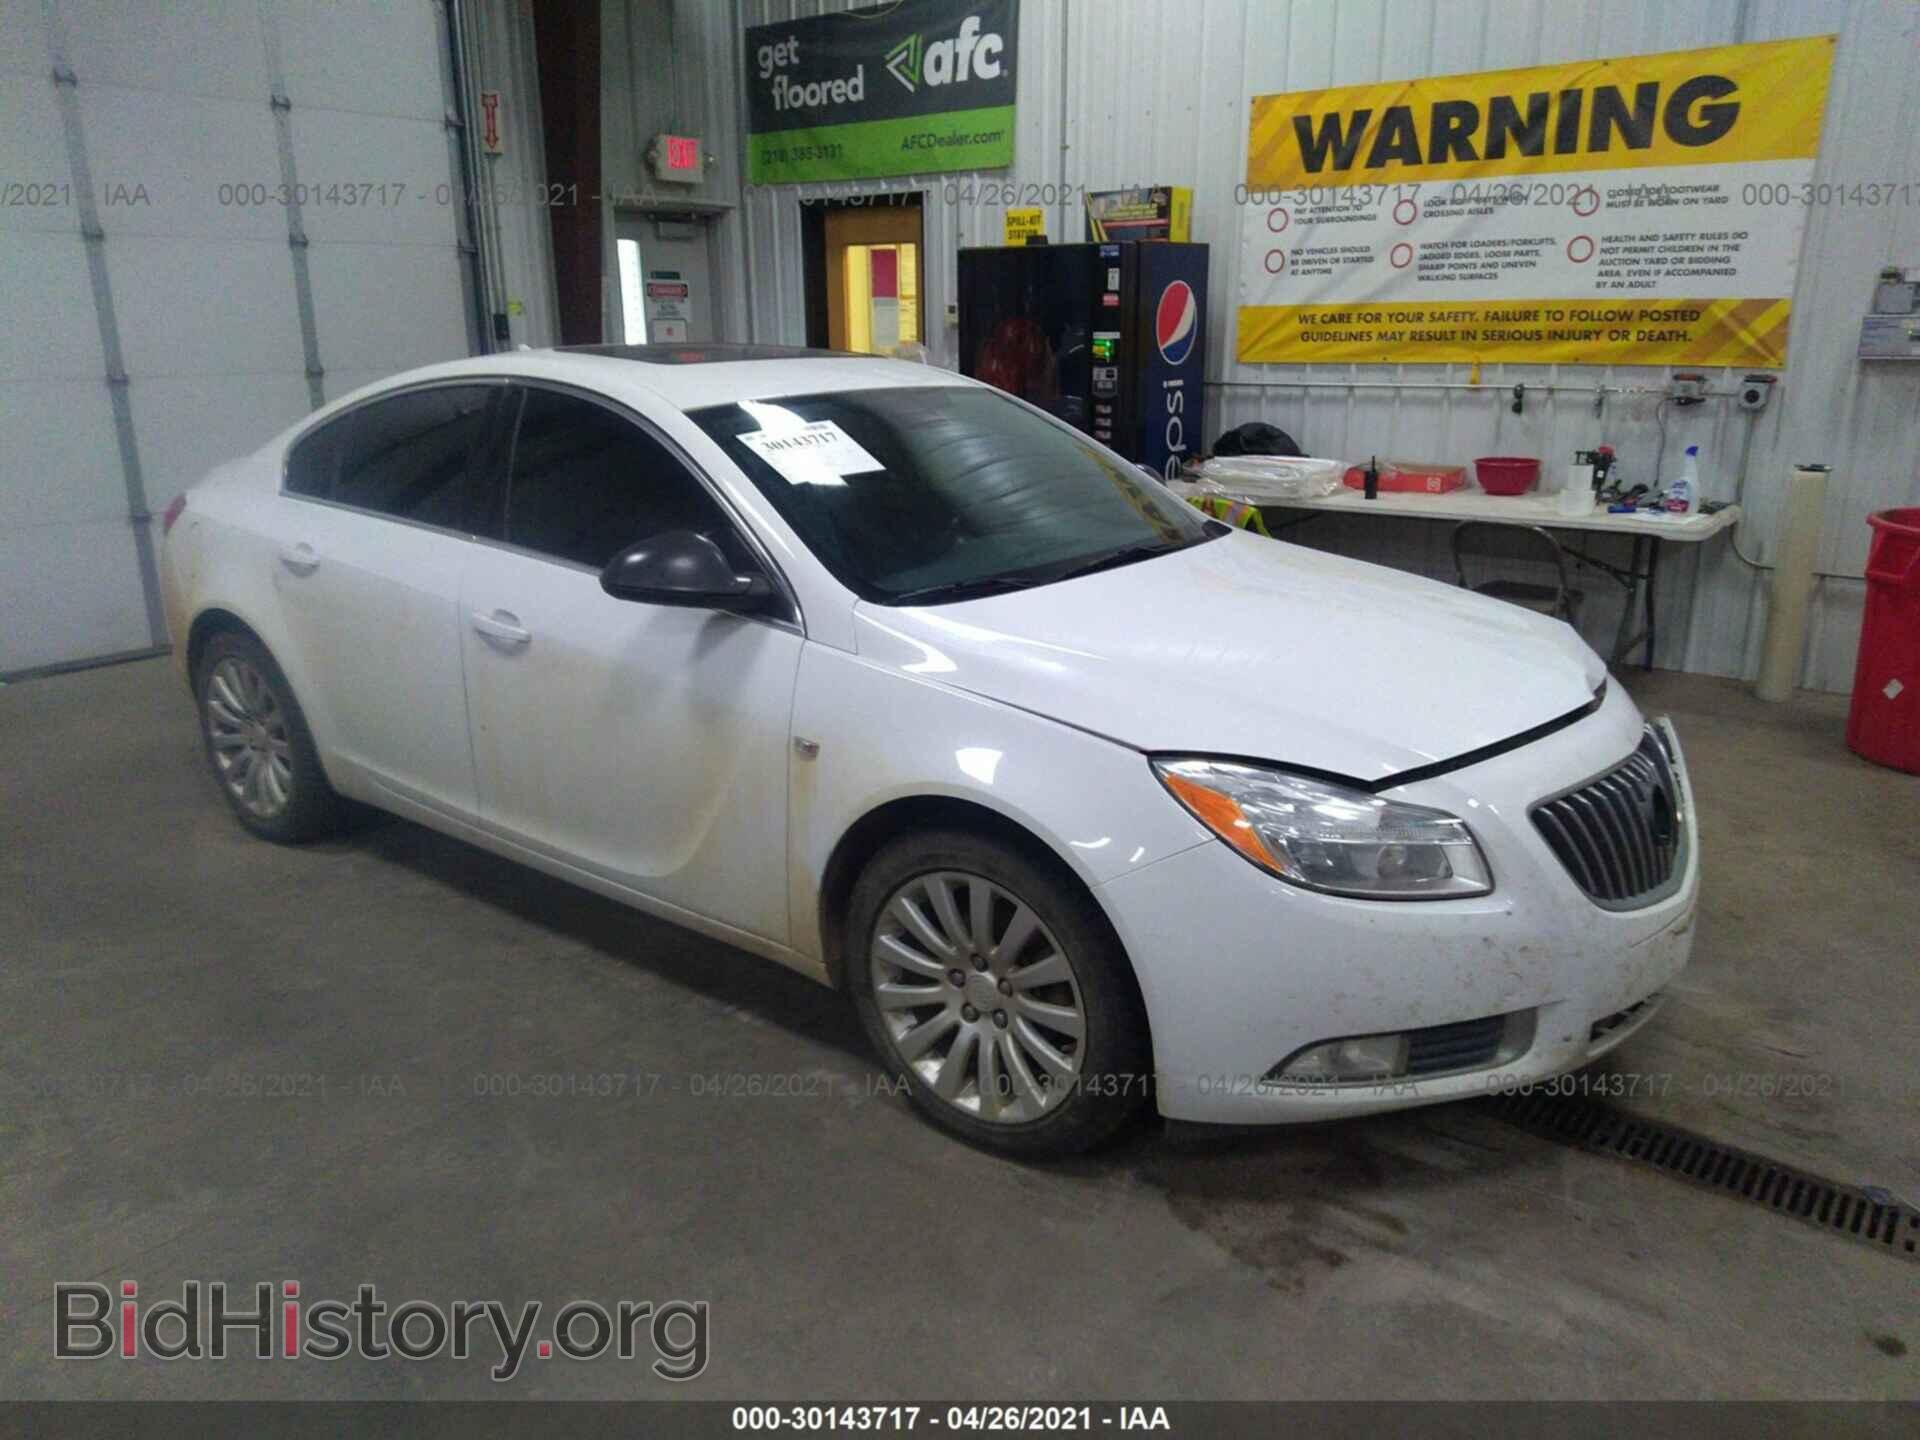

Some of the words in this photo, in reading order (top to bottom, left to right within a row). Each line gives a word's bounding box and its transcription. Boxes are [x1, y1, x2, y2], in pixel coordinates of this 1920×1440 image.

[758, 34, 800, 79] get
[923, 16, 1004, 87] afc
[772, 64, 864, 110] floored
[1293, 74, 1741, 173] WARNING
[902, 130, 1003, 151] AFCDealer.com
[1683, 197, 1698, 205] ON
[1703, 196, 1728, 204] YARD
[1424, 208, 1464, 218] CROSSING
[1601, 235, 1635, 243] HEALTH
[1639, 234, 1659, 242] AND
[1662, 233, 1696, 242] SAFETY
[1699, 232, 1728, 240] RULES
[1305, 247, 1338, 255] VEHICLES
[1420, 242, 1448, 250] WATCH
[1450, 241, 1467, 249] FOR
[1600, 247, 1620, 255] NOT
[1622, 246, 1654, 254] PERMIT
[1657, 244, 1704, 253] CHILDREN
[1707, 244, 1718, 252] IN
[1721, 243, 1741, 251] THE
[1484, 250, 1512, 259] LOOSE
[1418, 263, 1445, 271] SHARP
[1448, 262, 1477, 270] POINTS
[1501, 260, 1537, 269] UNEVEN
[1598, 258, 1641, 266] AUCTION
[1644, 257, 1667, 265] YARD
[1670, 256, 1684, 265] OR
[1417, 273, 1457, 281] WALKING
[1626, 268, 1651, 277] EVEN
[1653, 268, 1662, 276] IF
[1664, 267, 1737, 277] ACCOMPANIED
[1627, 280, 1656, 288] ADULT
[1298, 313, 1317, 325] WE
[1320, 312, 1352, 325] CARE
[1356, 312, 1382, 324] FOR
[1386, 311, 1424, 324] YOUR
[1484, 309, 1540, 322] FAILURE
[1544, 309, 1564, 322] TO
[1568, 309, 1634, 322] FOLLOW
[1638, 309, 1700, 322] POSTED
[1300, 330, 1373, 342] GUIDELINES
[1376, 330, 1404, 342] MAY
[1409, 329, 1457, 342] RESULT
[1461, 329, 1477, 342] IN
[1481, 329, 1543, 342] SERIOUS
[1547, 329, 1602, 342] INJURY
[1607, 329, 1631, 342] OR
[1636, 329, 1693, 342] DEATH.
